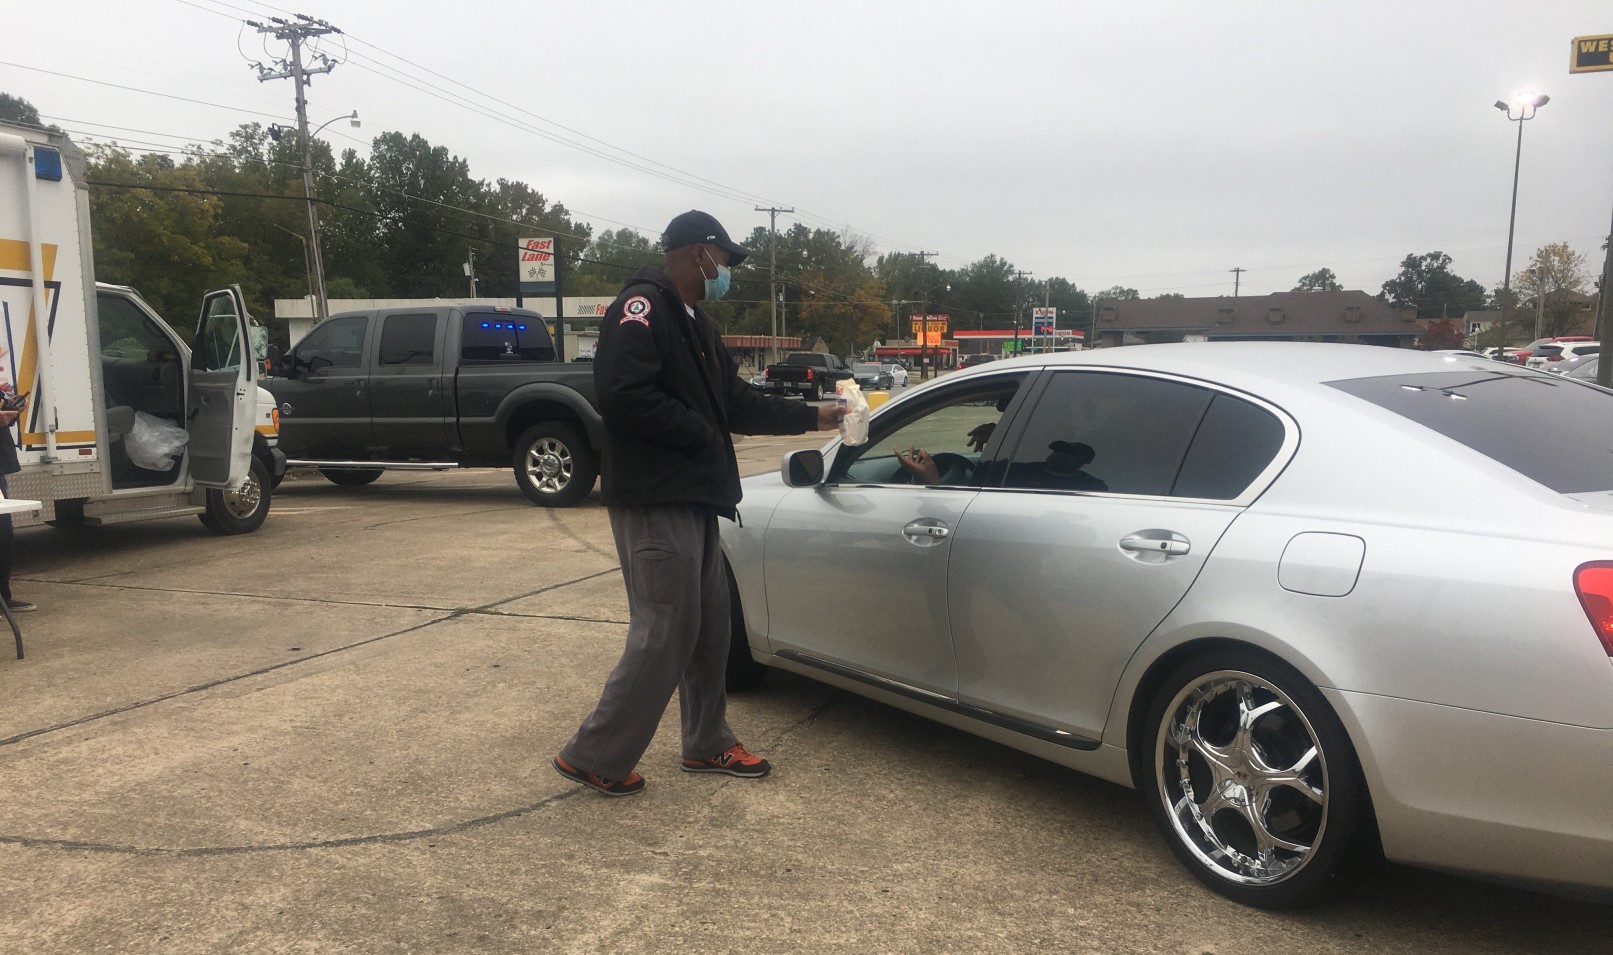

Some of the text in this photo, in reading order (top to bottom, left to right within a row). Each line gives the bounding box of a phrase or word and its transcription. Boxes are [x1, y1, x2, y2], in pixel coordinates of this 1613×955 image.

[525, 239, 552, 249] Fast
[521, 252, 550, 261] Lane
[595, 304, 608, 315] Fas
[712, 753, 734, 767] N
